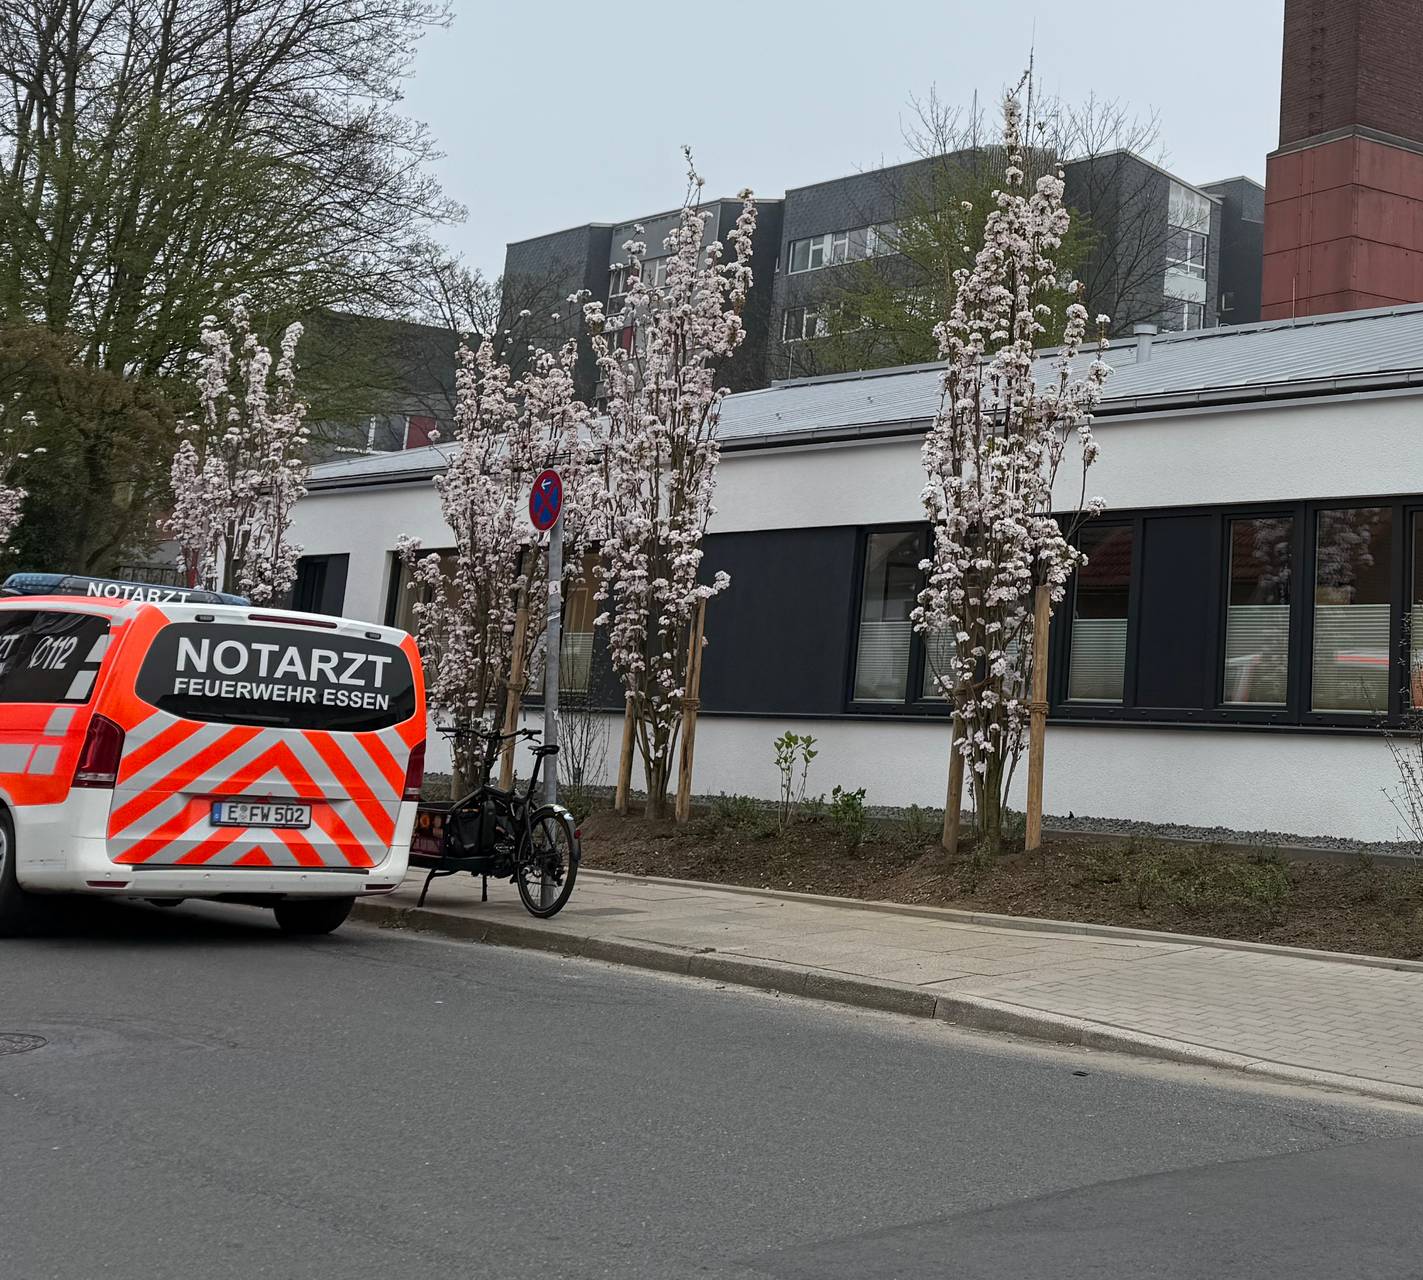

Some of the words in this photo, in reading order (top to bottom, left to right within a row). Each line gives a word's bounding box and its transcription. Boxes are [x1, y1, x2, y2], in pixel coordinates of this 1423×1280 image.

[87, 582, 191, 604] NOTARZT
[176, 637, 392, 689] NOTARZT
[173, 678, 317, 705] FEUERWEHR
[322, 689, 390, 711] ESSEN
[228, 805, 238, 821] E
[249, 806, 271, 822] FW
[275, 807, 304, 823] 502
